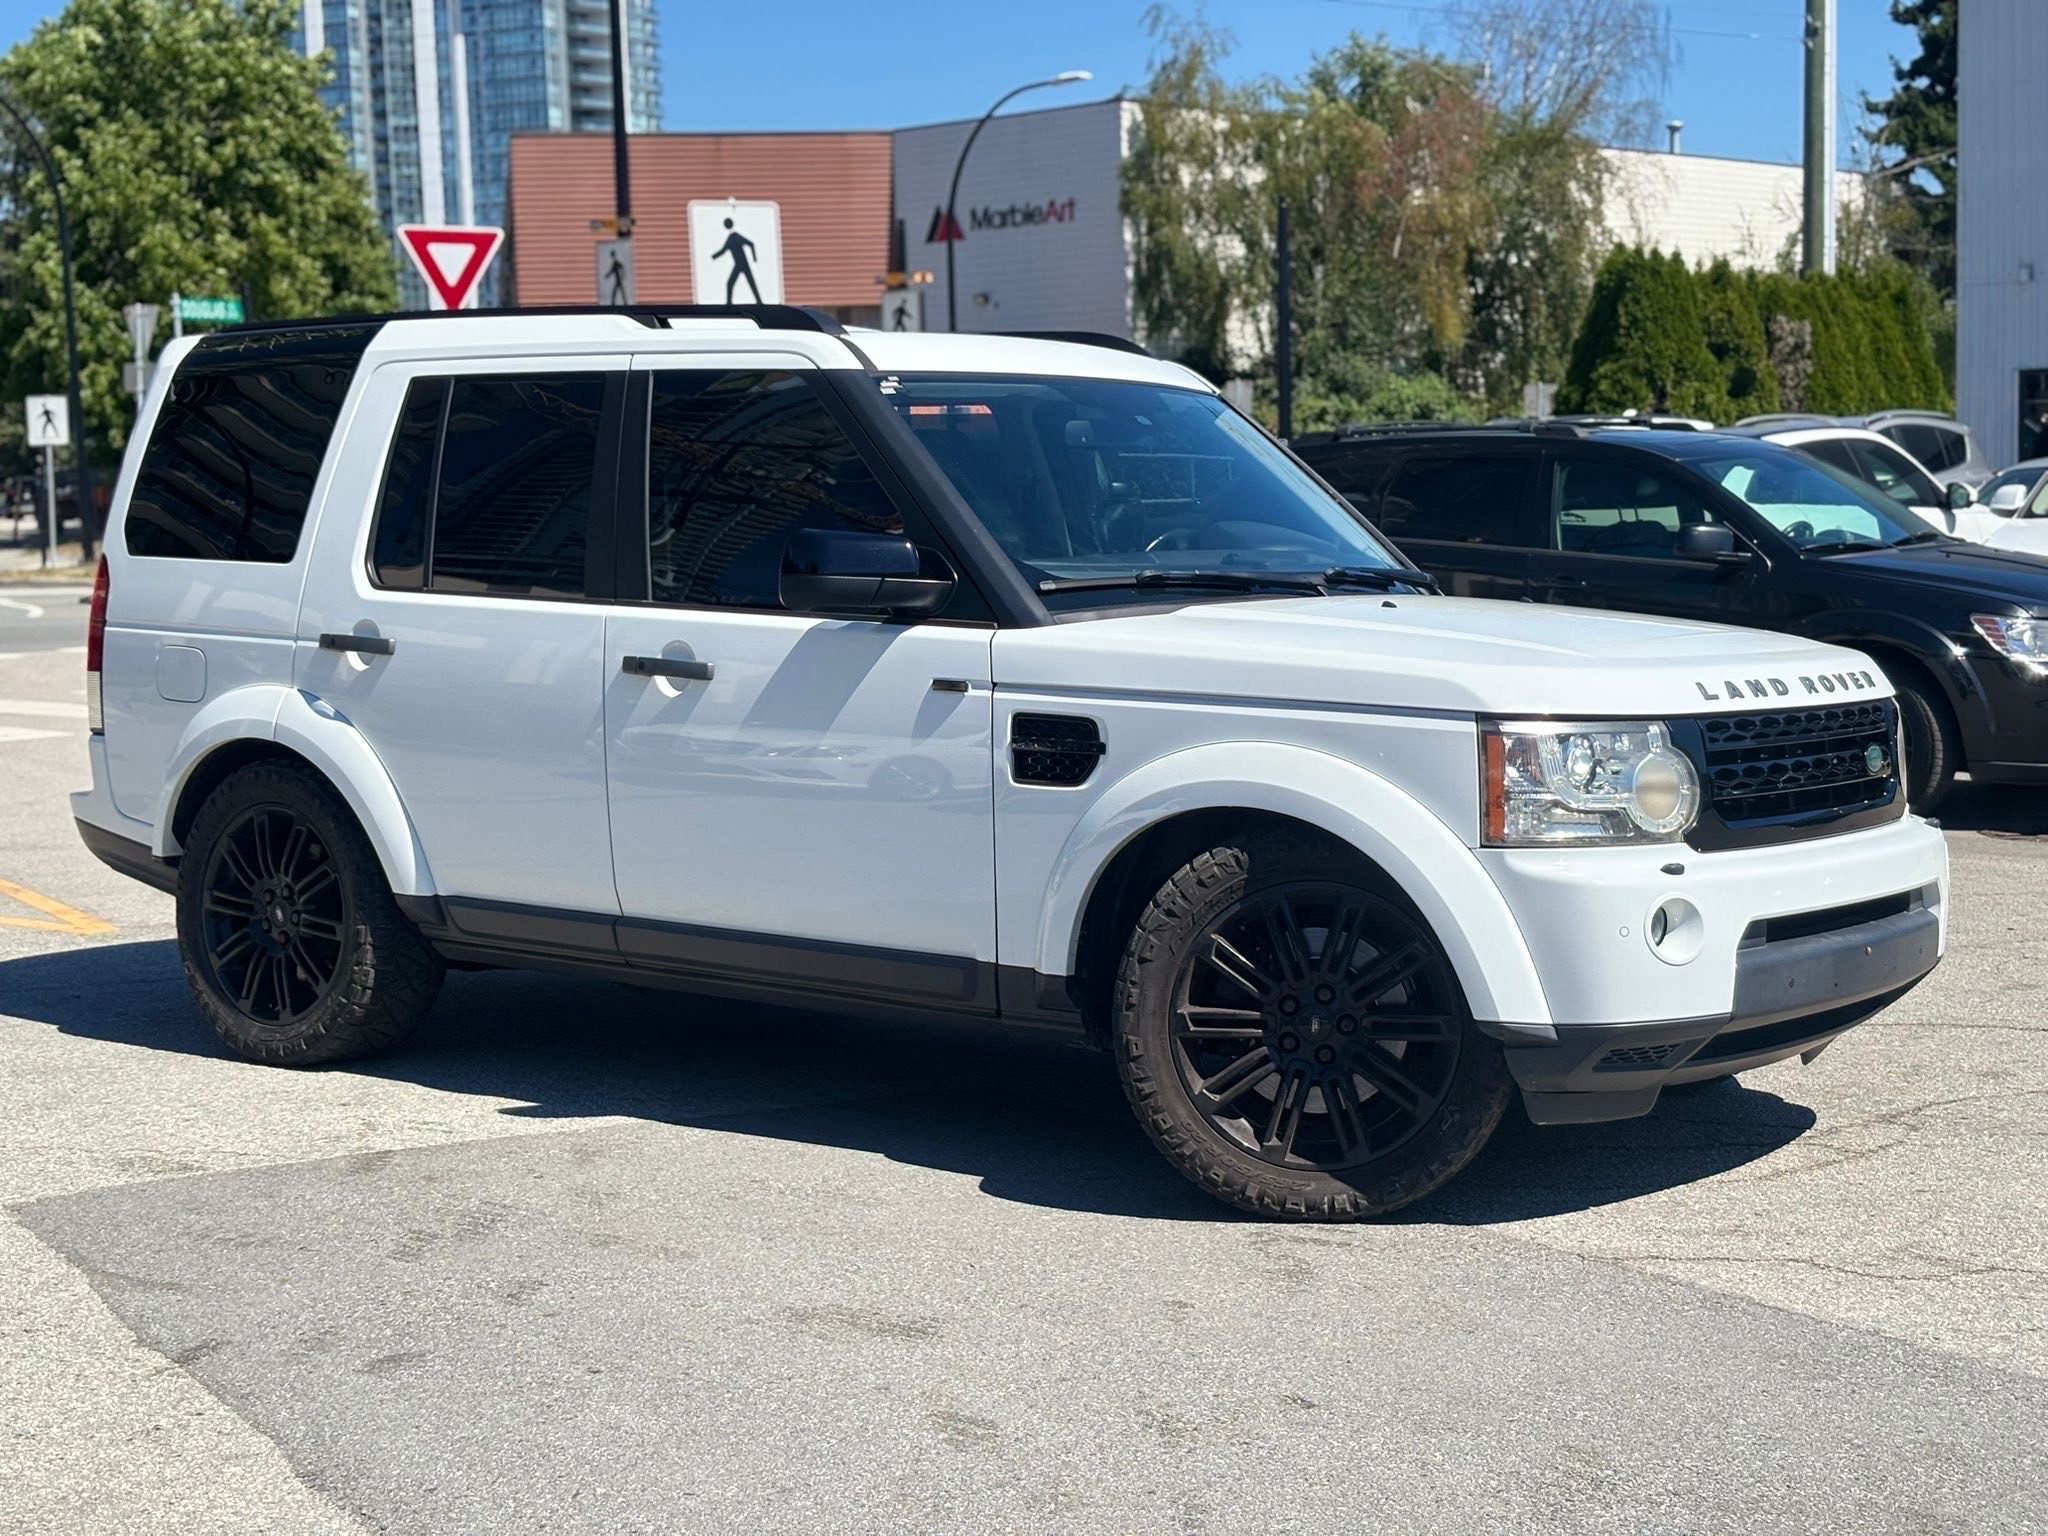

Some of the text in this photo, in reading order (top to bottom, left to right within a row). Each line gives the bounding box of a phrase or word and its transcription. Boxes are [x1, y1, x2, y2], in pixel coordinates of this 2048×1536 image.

[970, 198, 1075, 231] MarbleArt
[1695, 670, 1877, 701] LAND ROVER
